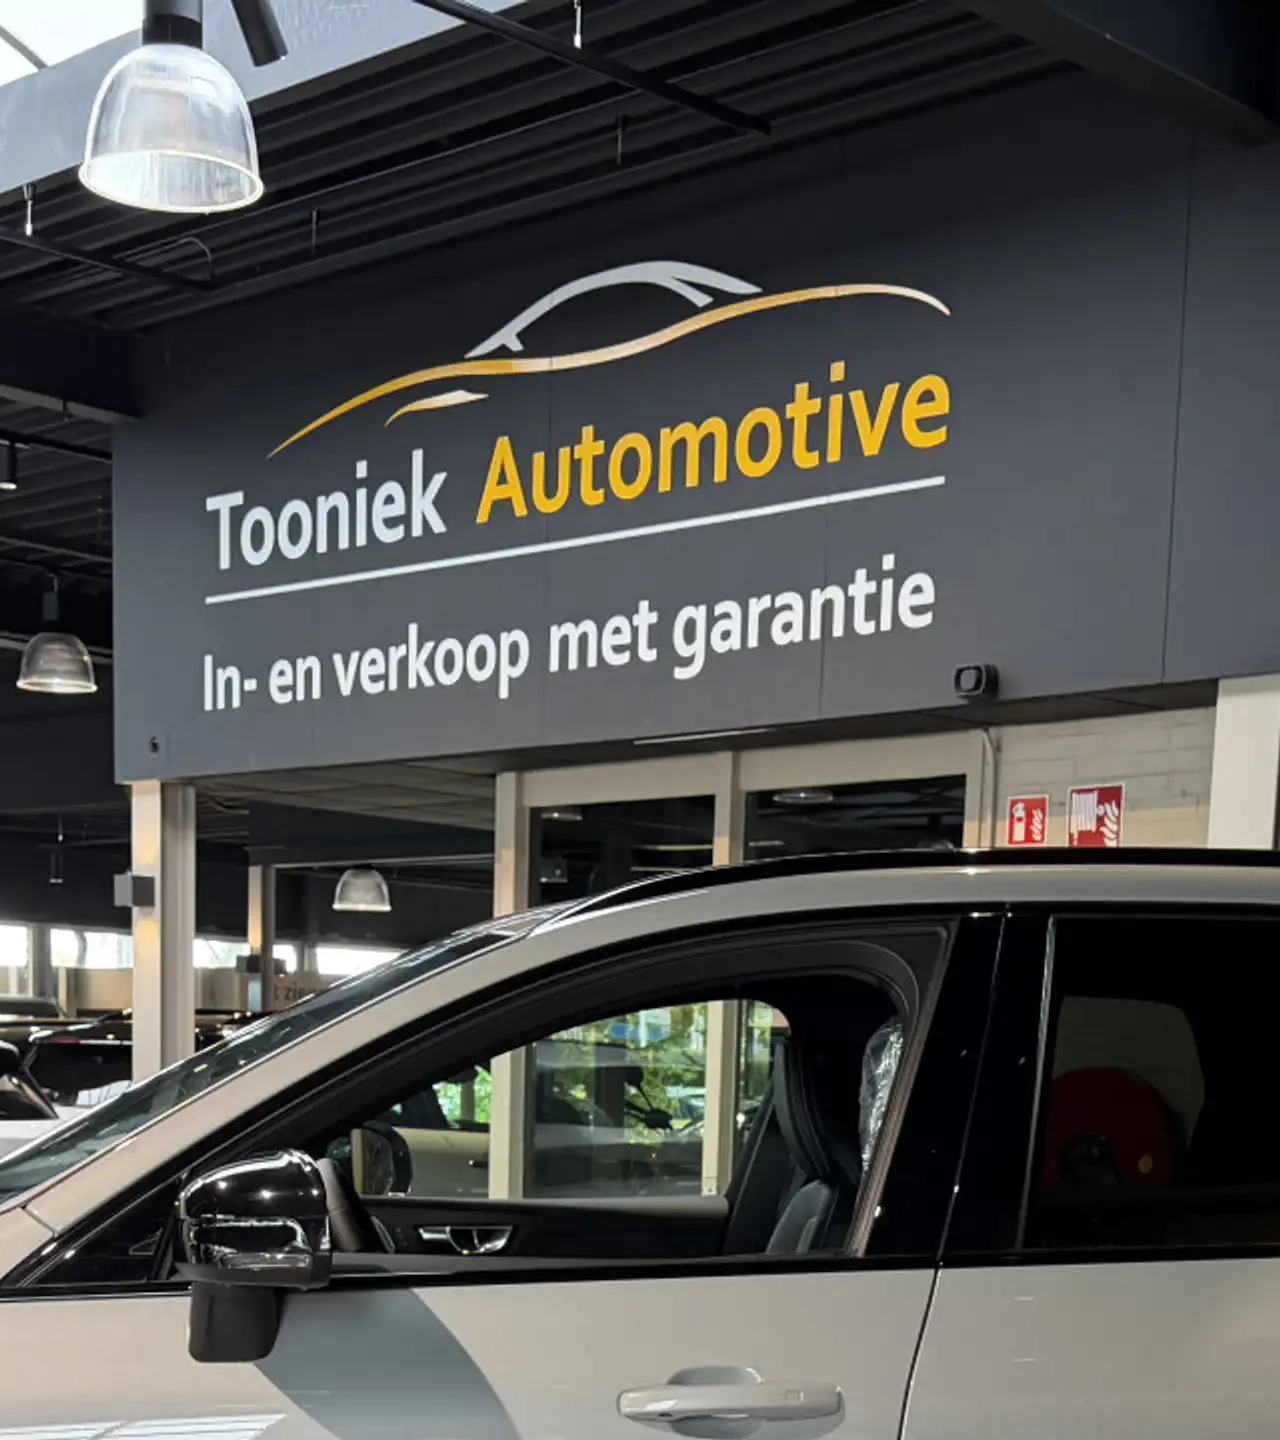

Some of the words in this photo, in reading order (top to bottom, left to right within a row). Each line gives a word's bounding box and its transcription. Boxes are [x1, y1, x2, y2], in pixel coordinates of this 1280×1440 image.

[205, 447, 449, 571] Tooniek
[475, 359, 951, 524] Automotive
[203, 652, 258, 712] In-
[269, 655, 322, 706] en
[332, 622, 530, 700] verkoop
[548, 599, 659, 673] met
[672, 553, 937, 681] garantie
